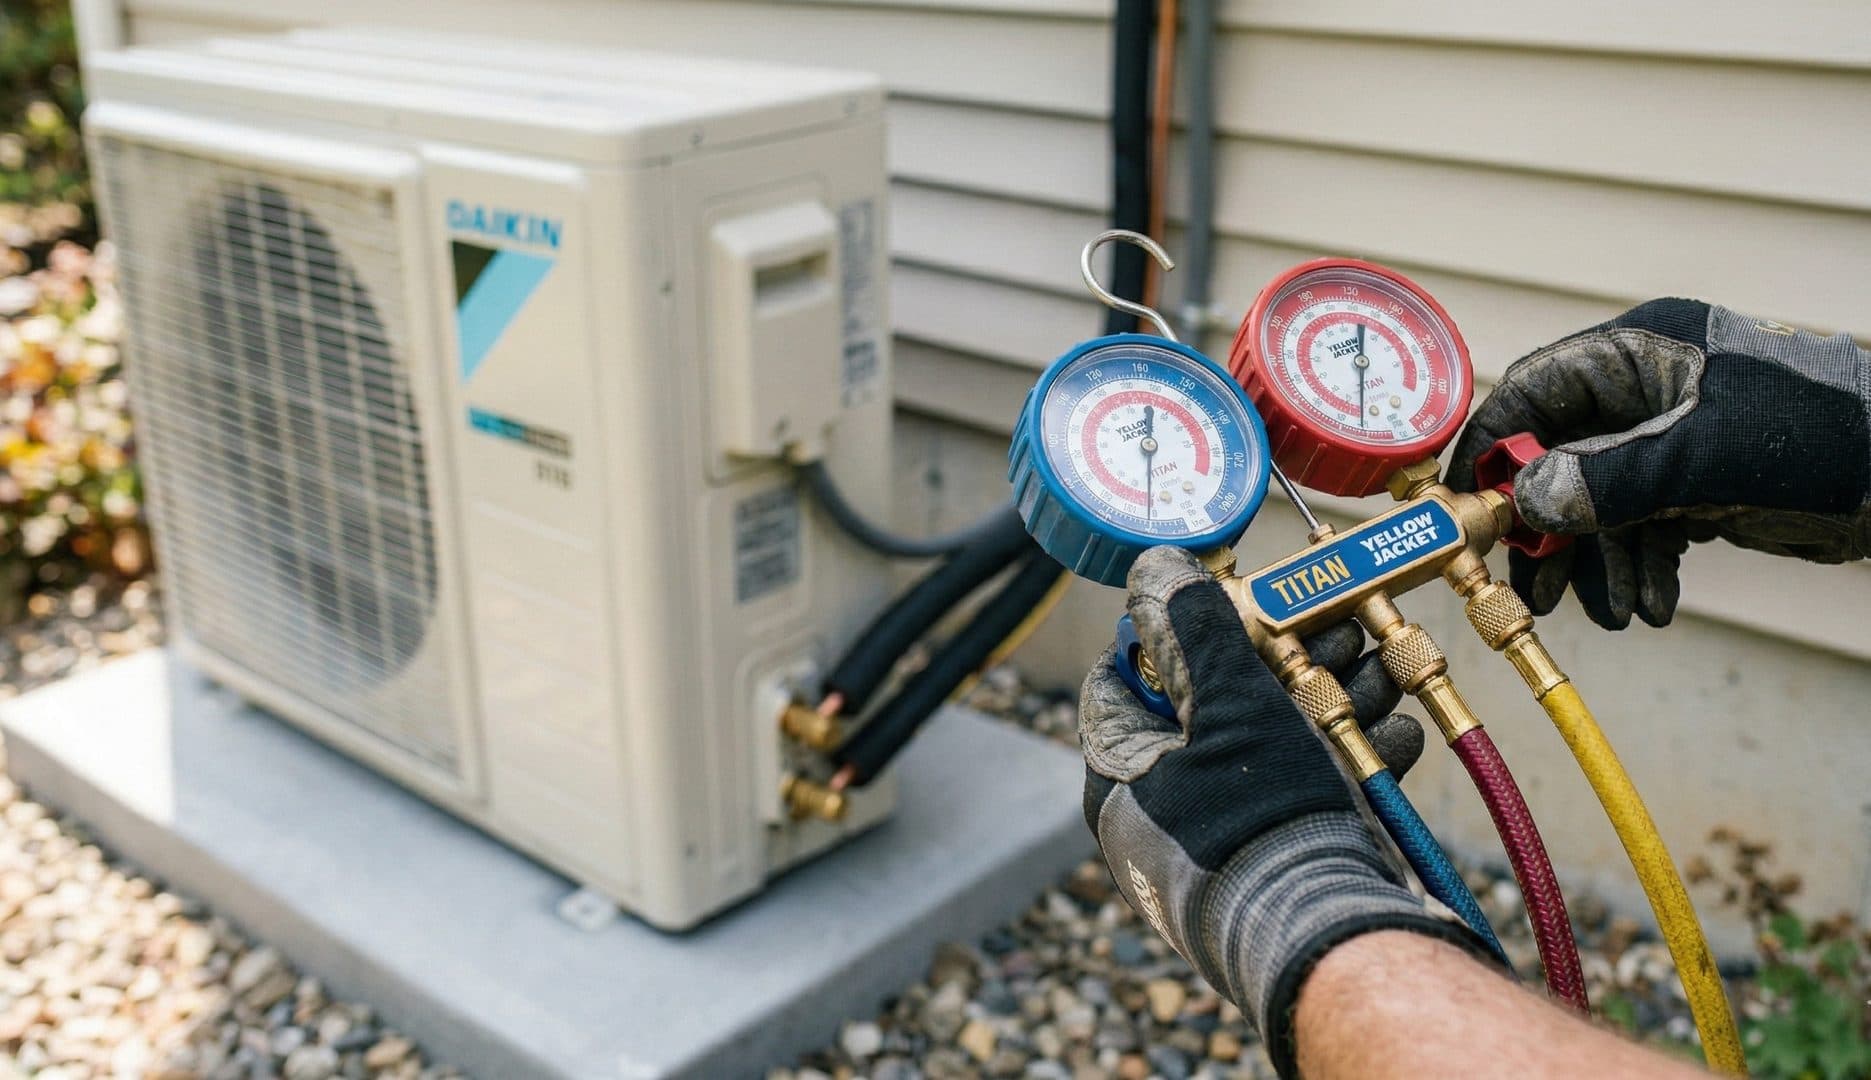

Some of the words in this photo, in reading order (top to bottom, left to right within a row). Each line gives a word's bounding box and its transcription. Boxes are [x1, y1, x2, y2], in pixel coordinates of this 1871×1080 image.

[446, 199, 563, 248] DAIKIN
[1327, 337, 1358, 352] YELLOW
[1360, 511, 1433, 552] YELLOW
[1374, 526, 1439, 567] JACKET
[1270, 555, 1351, 605] TITAN
